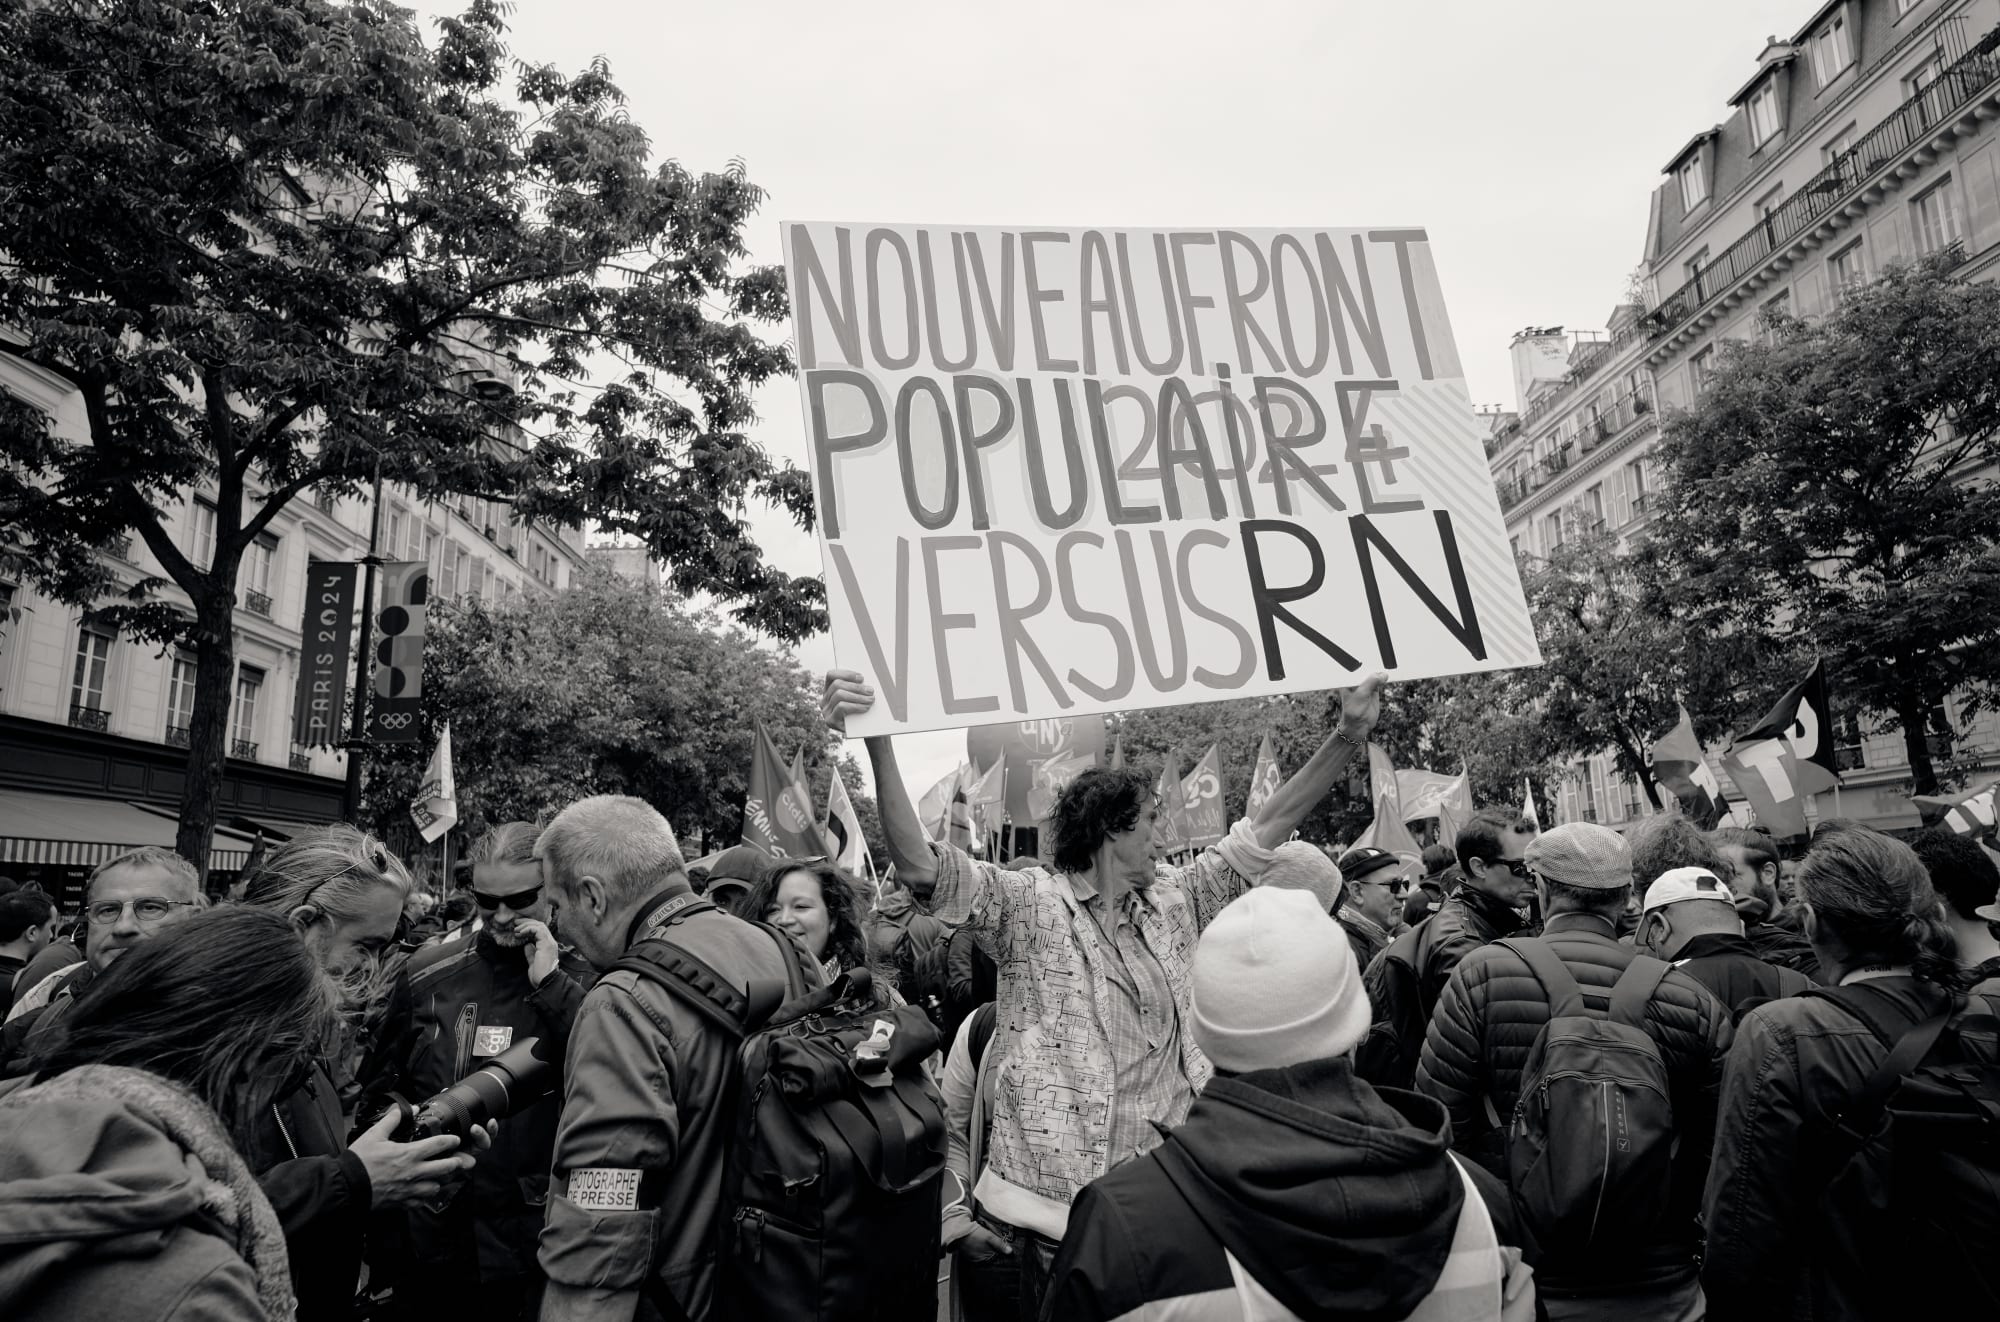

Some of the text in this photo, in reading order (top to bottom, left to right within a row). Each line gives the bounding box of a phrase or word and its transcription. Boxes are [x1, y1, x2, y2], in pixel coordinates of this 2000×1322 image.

[318, 575, 342, 642] 2024
[829, 510, 1488, 723] VERSUS RN
[488, 1028, 505, 1054] cgt
[580, 1191, 634, 1206] PRESSE
